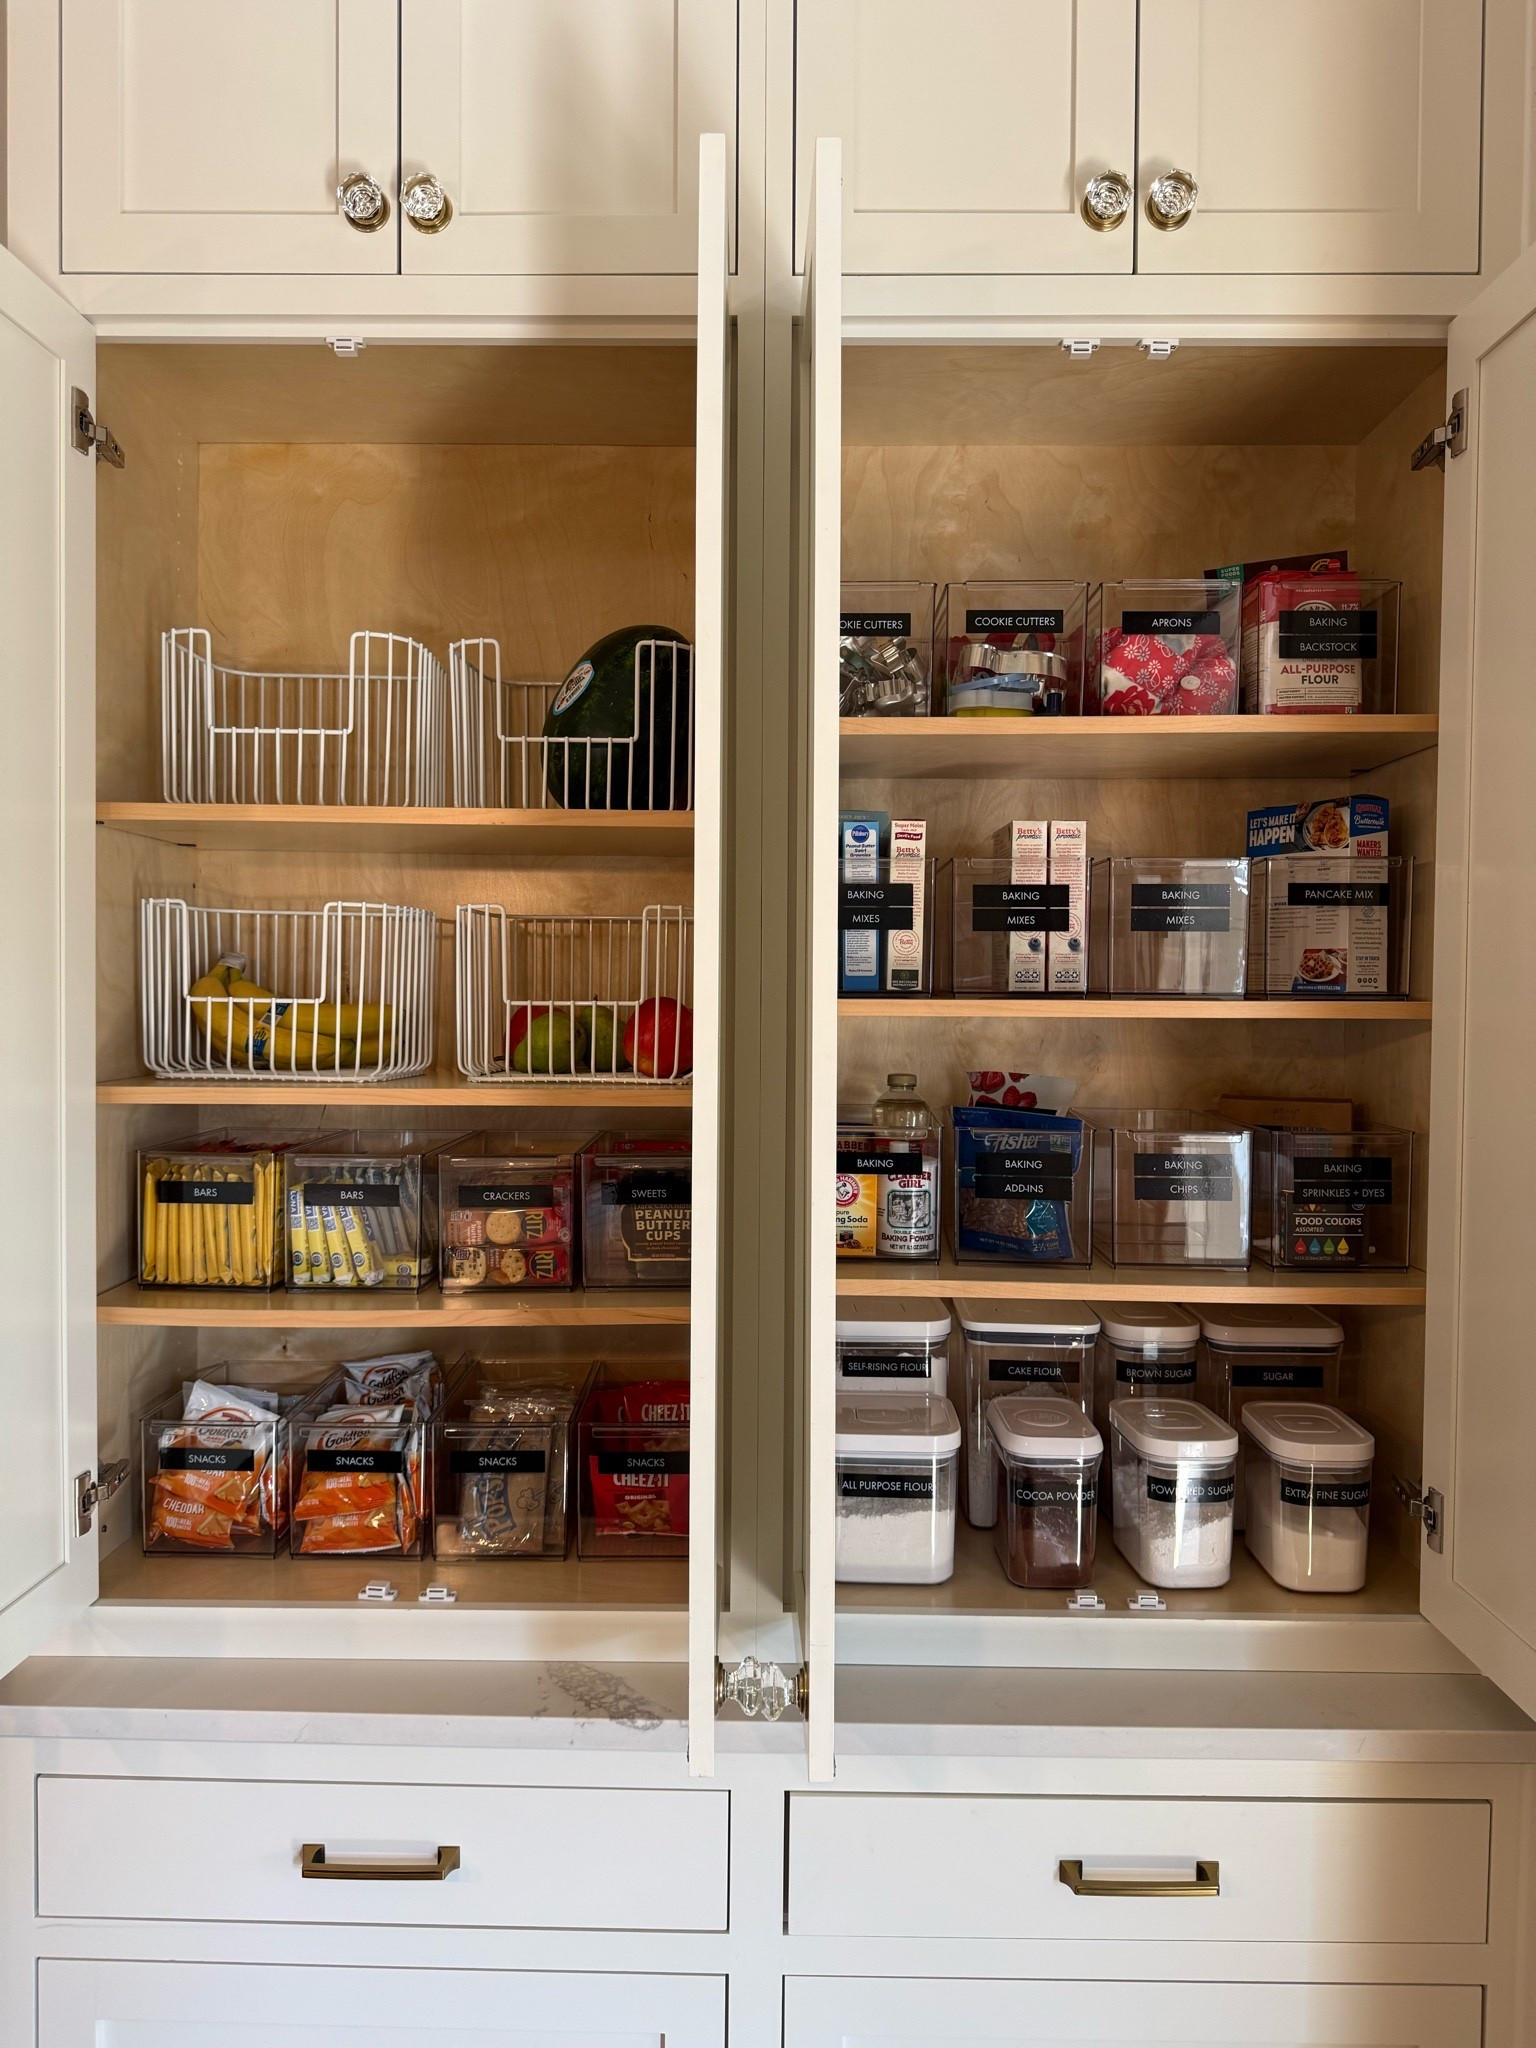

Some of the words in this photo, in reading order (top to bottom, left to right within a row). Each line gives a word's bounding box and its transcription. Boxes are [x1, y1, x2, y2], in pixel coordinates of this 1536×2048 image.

[840, 620, 861, 629] OKIE
[863, 620, 903, 630] CUTTERS
[974, 617, 1013, 627] COOKIE
[1015, 616, 1056, 626] CUTTERS
[1151, 617, 1192, 628] APRONS
[1309, 617, 1348, 627] BAKING
[1300, 642, 1357, 652] BACKSTOCK
[1280, 664, 1356, 675] ALL-PURPOSE
[1301, 675, 1339, 685] FLOUR
[1250, 817, 1268, 829] LET'S
[1269, 813, 1288, 826] MAKE
[1288, 813, 1297, 824] IT
[1249, 825, 1295, 847] HAPPEN
[1356, 840, 1382, 848] MAKERS
[1356, 848, 1382, 857] WANTED
[847, 890, 884, 900] BAKING
[1002, 891, 1040, 901] BAKING
[1161, 891, 1200, 900] BAKING
[1305, 889, 1352, 899] PANCAKE
[1354, 889, 1373, 899] MIX
[852, 914, 880, 923] MIXES
[1007, 915, 1035, 925] MIXES
[1166, 916, 1195, 925] MIXES
[837, 1141, 868, 1150] ABBER
[985, 1132, 1043, 1153] Fisher
[857, 1159, 894, 1168] BAKING
[1005, 1160, 1043, 1169] BAKING
[1164, 1161, 1203, 1170] BAKING
[1323, 1164, 1362, 1173] BAKING
[899, 1180, 923, 1188] GIRL
[1004, 1184, 1044, 1193] ADD-INS
[194, 1188, 218, 1197] BARS
[631, 1189, 667, 1198] SWEETS
[1170, 1185, 1198, 1194] CHIPS
[1302, 1189, 1350, 1198] SPRINKLES
[1361, 1189, 1385, 1198] DYES
[340, 1190, 364, 1200] BARS
[483, 1191, 530, 1201] CRACKERS
[634, 1210, 691, 1220] PEANUT
[525, 1211, 544, 1239] RITZ
[636, 1220, 691, 1230] BUTTER
[1295, 1217, 1323, 1226] FOOD
[1324, 1217, 1362, 1226] COLORS
[646, 1231, 681, 1240] CUPS
[881, 1232, 908, 1242] BAKING
[909, 1233, 934, 1242] POWDER
[534, 1250, 555, 1279] RITZ
[848, 1362, 898, 1371] SELF-RISING
[900, 1363, 928, 1371] FLOUR
[1008, 1366, 1032, 1375] CAKE
[1033, 1367, 1062, 1376] FLOUR
[1126, 1368, 1162, 1378] BROWN
[1164, 1368, 1192, 1378] SUGAR
[1262, 1372, 1294, 1381] SUGAR
[188, 1454, 227, 1464] SNACKS
[336, 1456, 375, 1466] SNACKS
[478, 1457, 518, 1466] SNACKS
[627, 1458, 665, 1467] SNACKS
[842, 1480, 857, 1490] ALL
[859, 1481, 901, 1491] PURPOSE
[903, 1482, 934, 1491] FLOUR
[1150, 1483, 1205, 1496] POWRED
[1016, 1489, 1054, 1500] COCOA
[1056, 1490, 1095, 1500] POWDER
[1285, 1486, 1313, 1499] EXTRA
[1316, 1490, 1339, 1500] FINE
[163, 1497, 205, 1515] CHEDDAR
